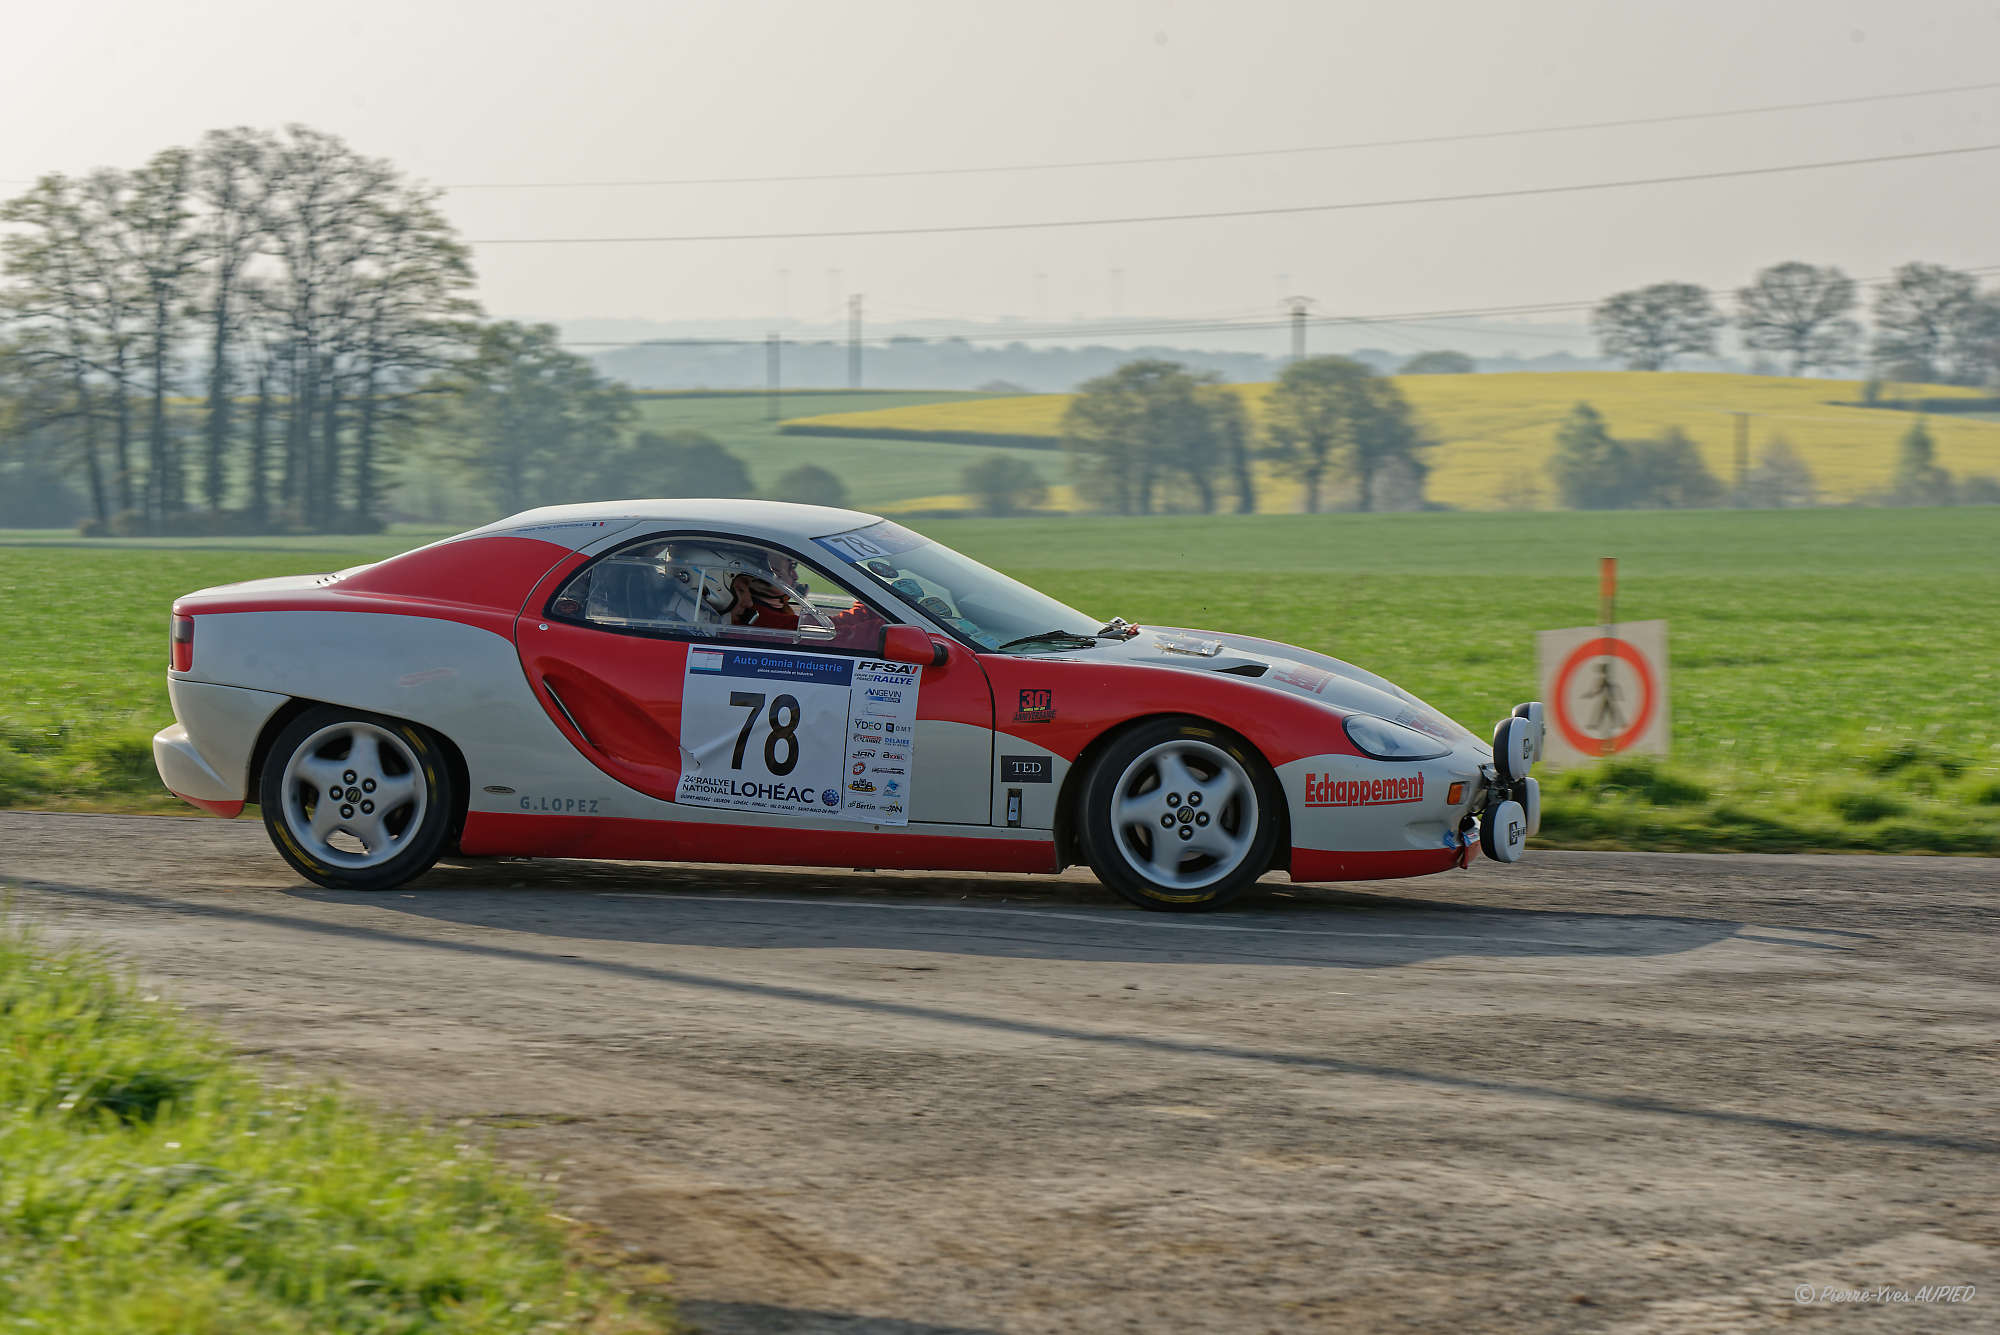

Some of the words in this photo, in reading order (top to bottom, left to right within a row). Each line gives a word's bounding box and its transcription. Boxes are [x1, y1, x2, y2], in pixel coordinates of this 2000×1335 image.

[831, 534, 881, 557] 78
[733, 655, 758, 665] Auto
[761, 657, 793, 668] Omnia
[796, 660, 843, 673] Industrie
[858, 661, 911, 675] FFSA
[873, 675, 913, 685] RALLYE
[864, 688, 902, 698] ANGEVIN
[729, 690, 801, 777] 78
[1010, 761, 1042, 773] TED
[696, 776, 729, 787] RALLYE
[682, 783, 729, 795] NATIONAL
[730, 780, 815, 804] LOHÉAC
[1304, 771, 1424, 807] Echappement
